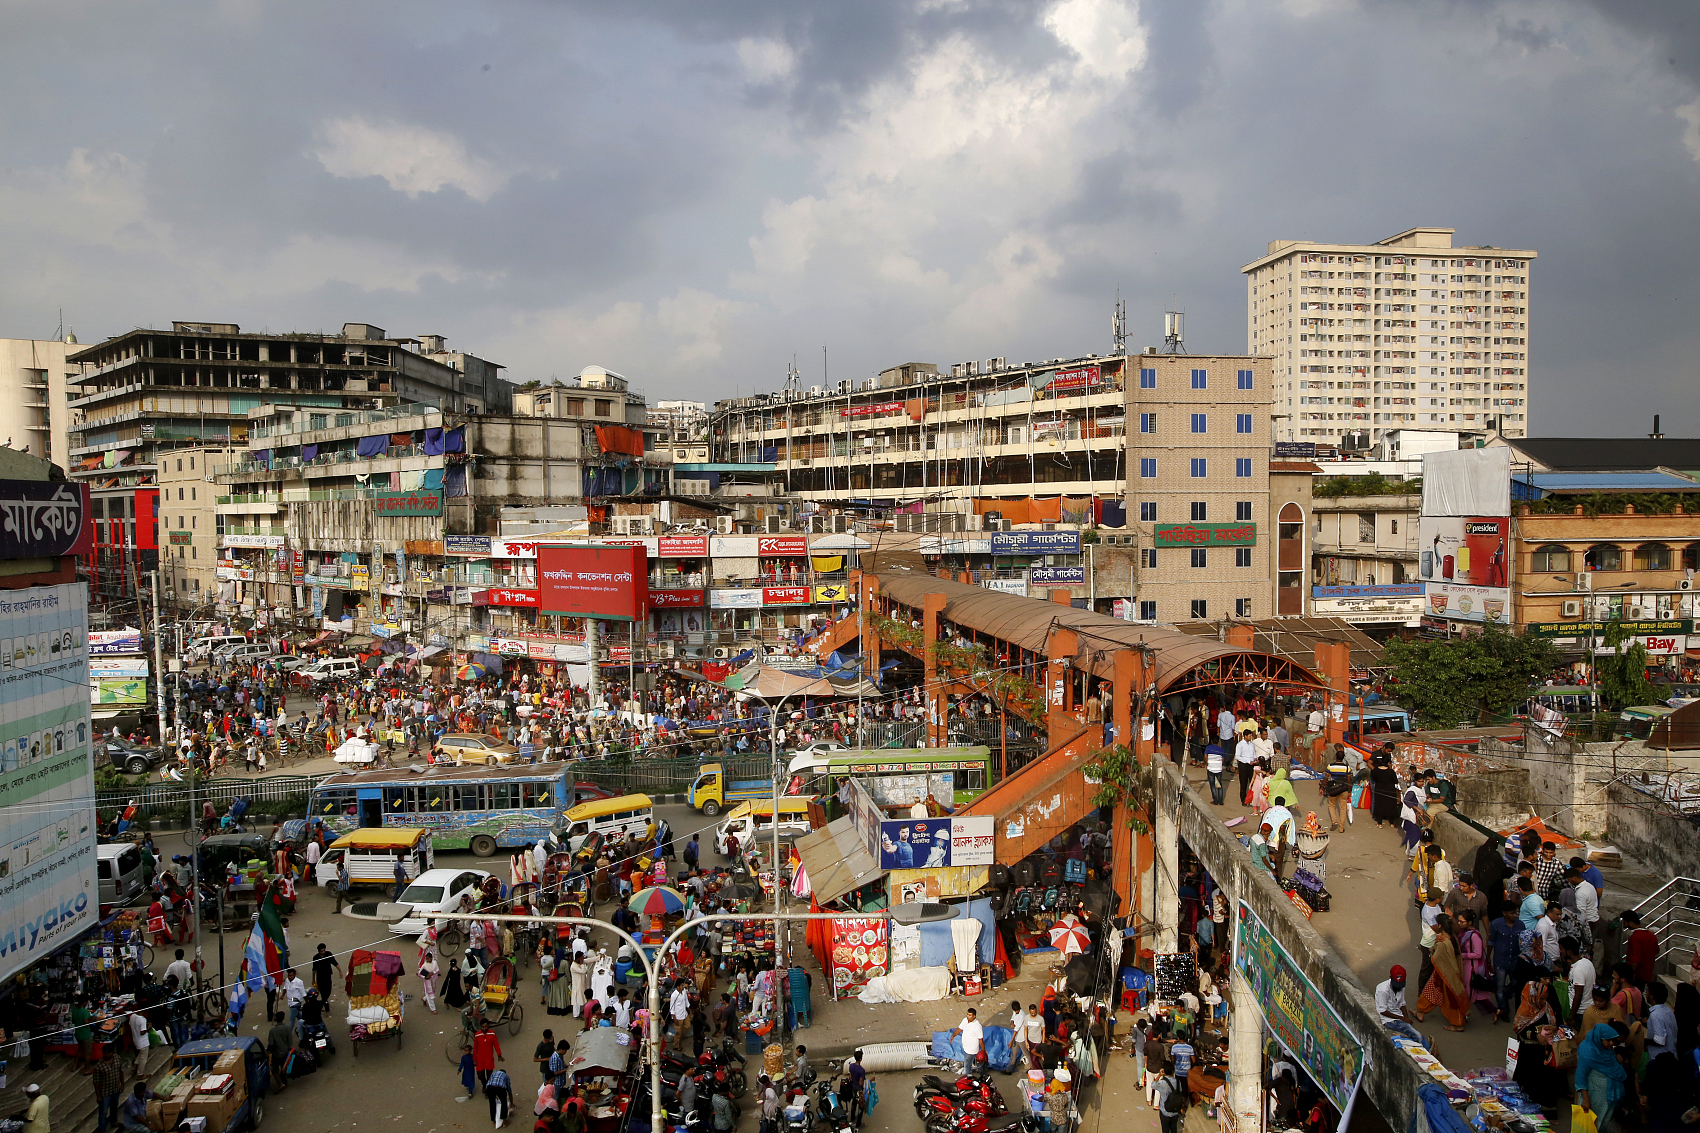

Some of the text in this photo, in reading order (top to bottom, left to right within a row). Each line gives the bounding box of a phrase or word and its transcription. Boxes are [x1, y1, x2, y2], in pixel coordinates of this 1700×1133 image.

[0, 484, 80, 544] মার্কেট
[1158, 525, 1255, 544] গাউছিয়া মার্কেট
[1472, 524, 1497, 533] president
[760, 539, 779, 551] RK
[993, 533, 1028, 546] মৌসুমী
[1032, 533, 1078, 543] গার্মেন্টস
[577, 572, 612, 582] কনভেনশন
[1032, 568, 1083, 580] মৌসুমী গার্মেন্টস
[767, 589, 804, 598] চন্দ্রালয়
[1363, 586, 1385, 594] শপিং
[42, 595, 58, 608] রাহীম
[1647, 637, 1675, 653] Bay
[953, 825, 964, 833] নিউ
[952, 836, 972, 848] আনন্দ
[38, 911, 87, 945] Parts of your life
[1283, 994, 1301, 1022] BRAZIL
